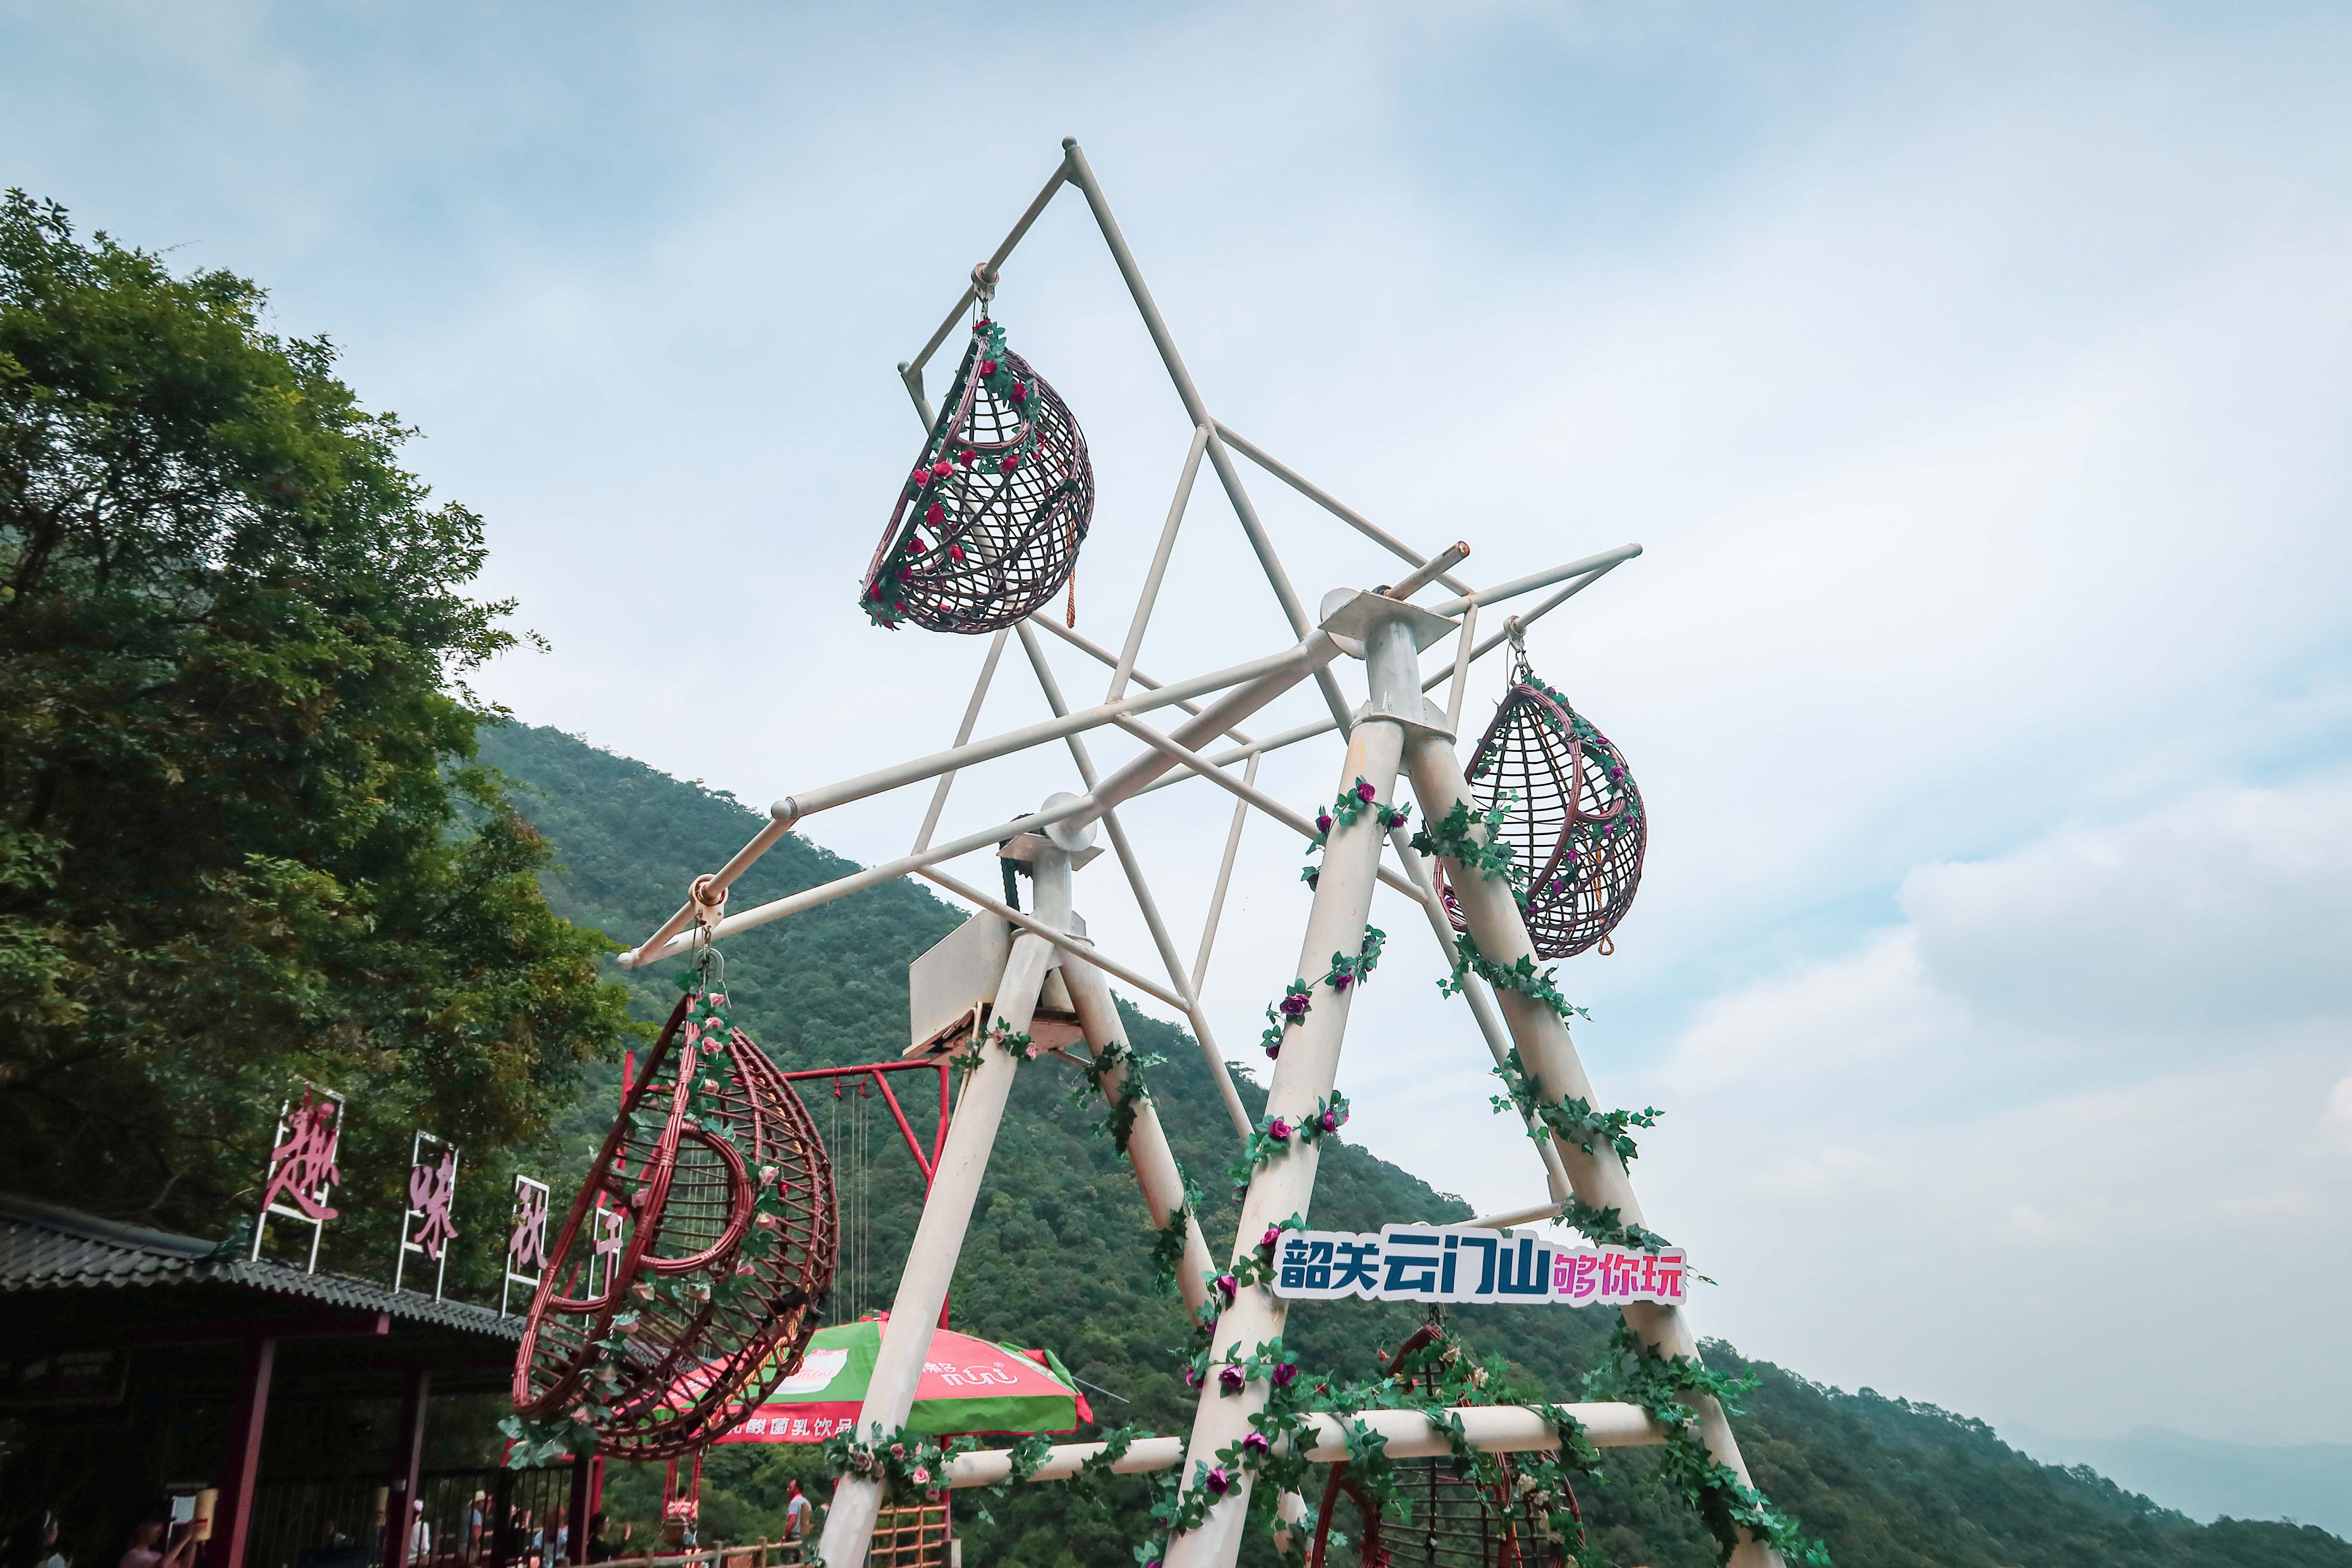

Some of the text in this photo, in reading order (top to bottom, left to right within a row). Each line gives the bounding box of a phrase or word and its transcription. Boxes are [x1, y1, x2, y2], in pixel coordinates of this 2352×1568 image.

[1280, 1233, 1681, 1298] 韶关云门山够你玩
